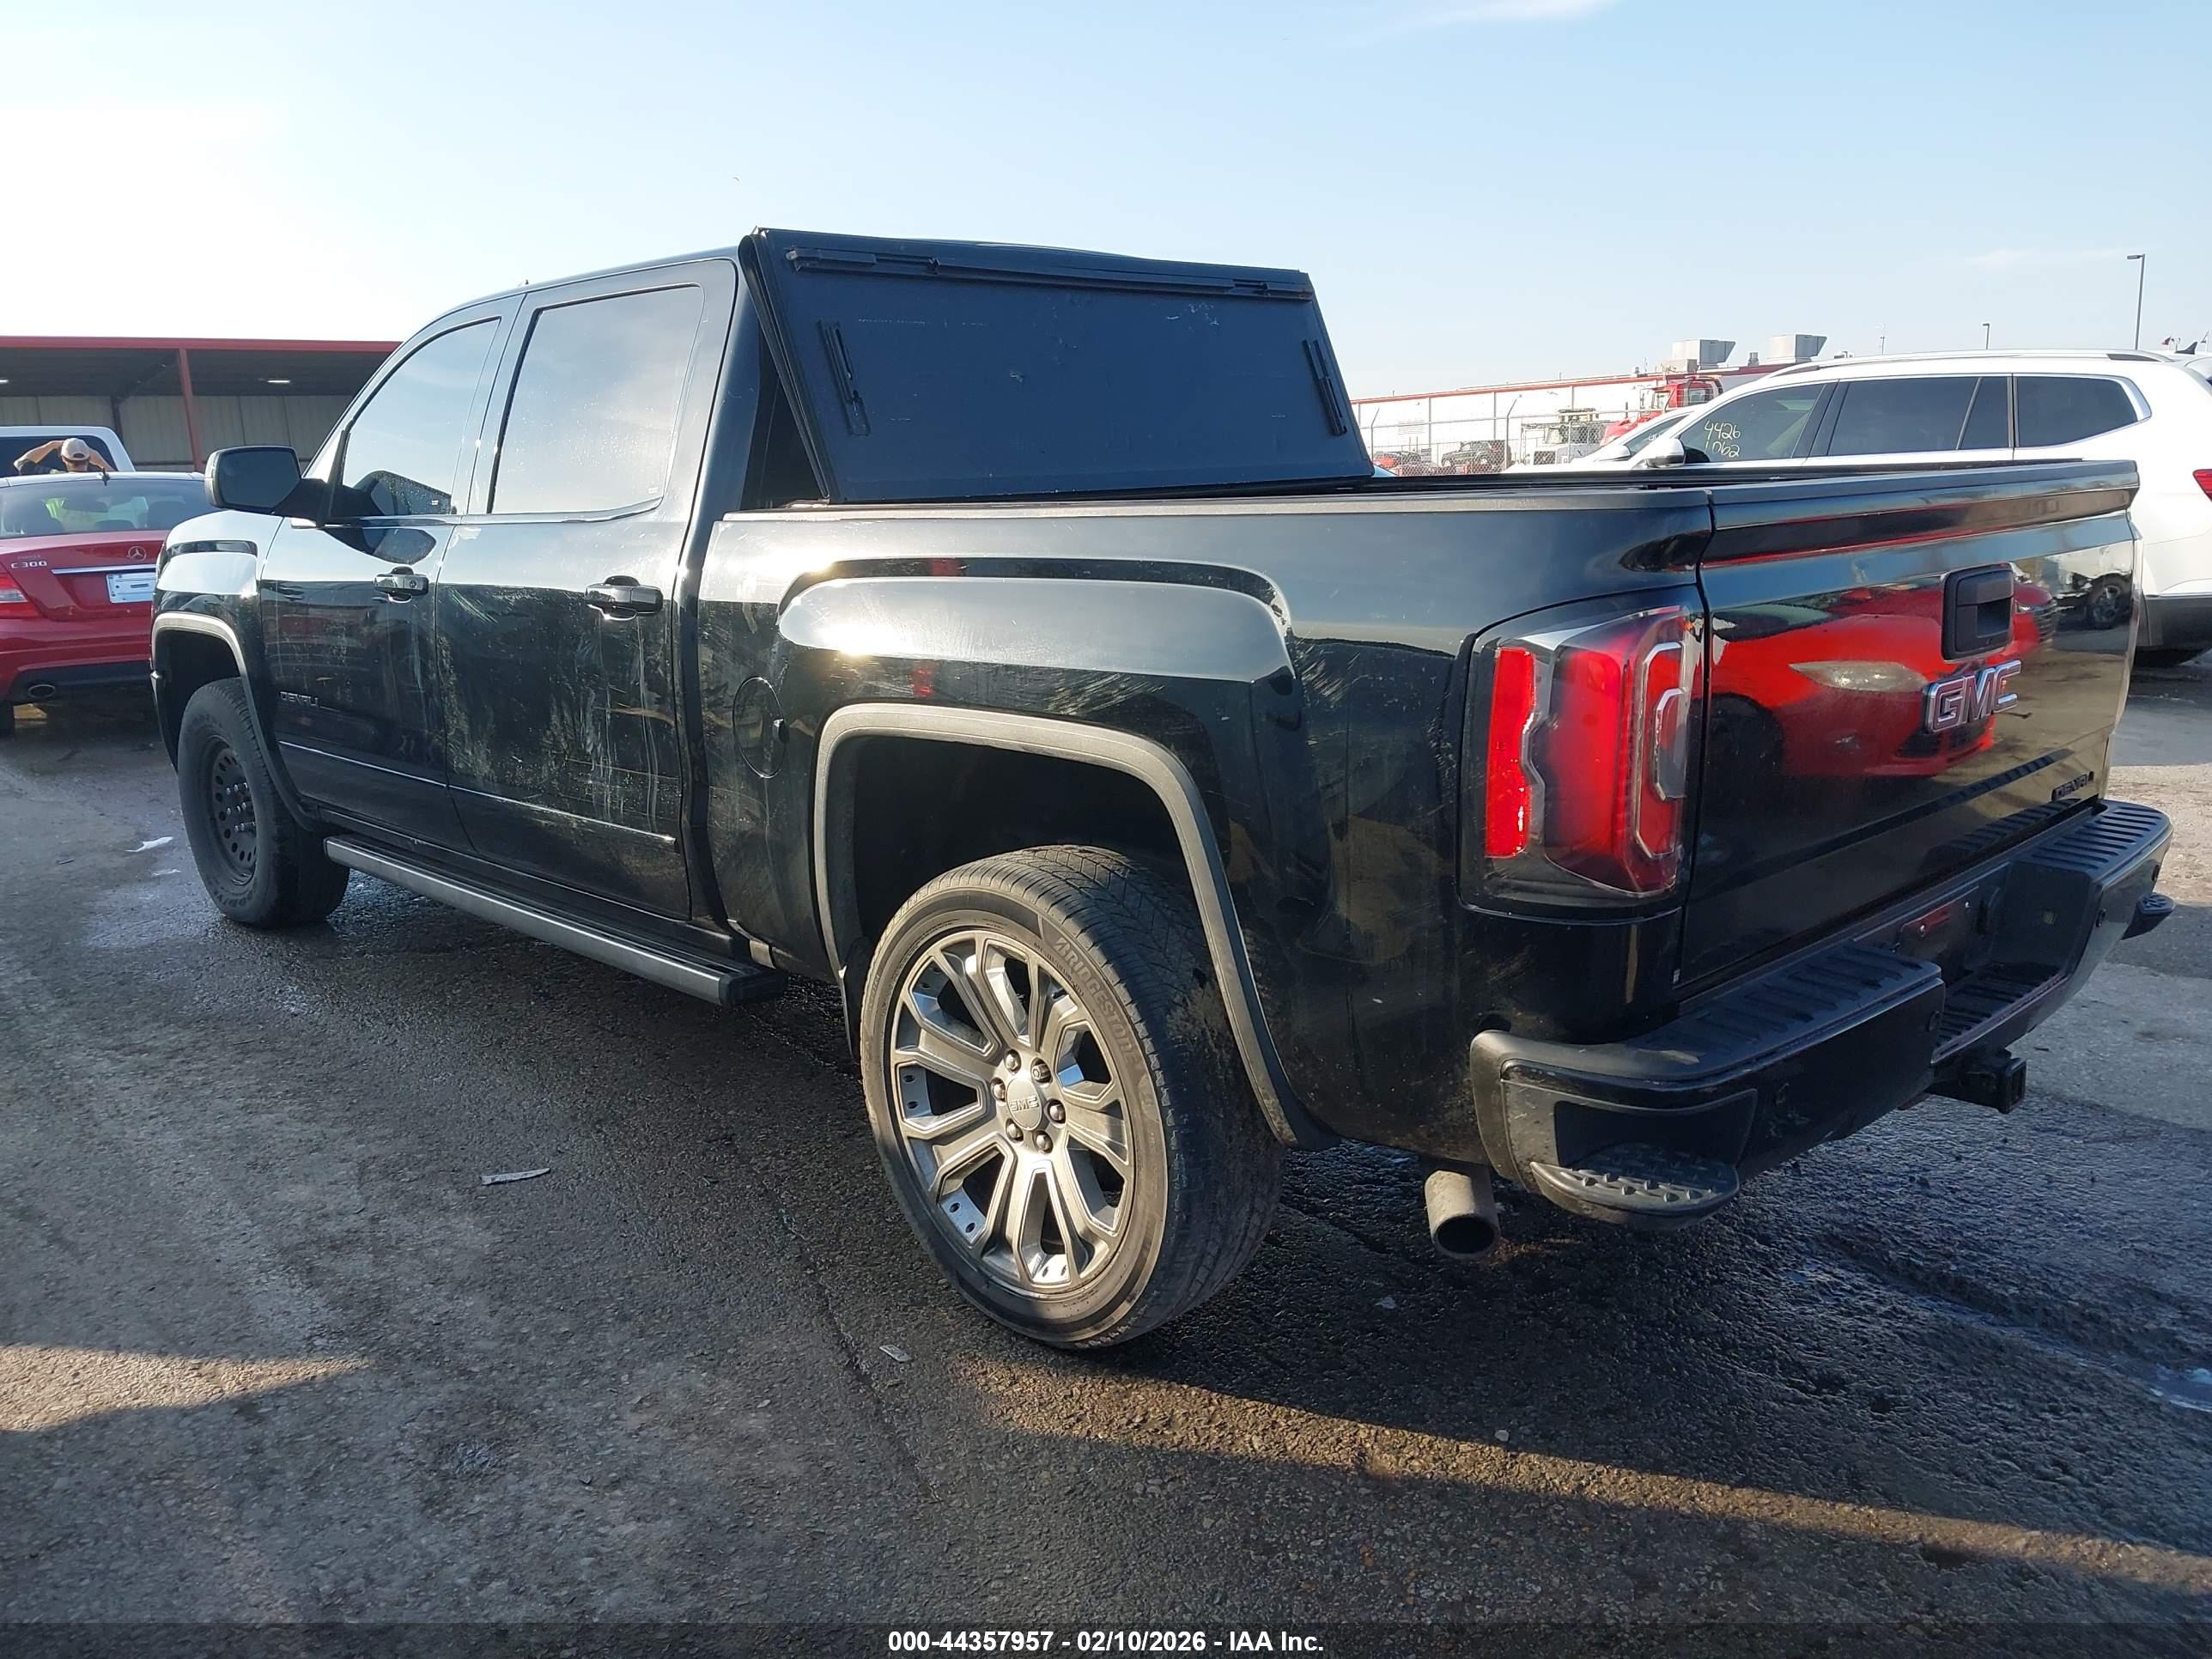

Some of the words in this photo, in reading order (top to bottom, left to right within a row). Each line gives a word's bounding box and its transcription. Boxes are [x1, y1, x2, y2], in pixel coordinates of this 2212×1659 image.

[1705, 420, 1741, 440] 4426
[1705, 440, 1741, 458] 1062
[279, 690, 319, 708] DENALI
[1925, 660, 2021, 733] GMC
[1053, 938, 1141, 1065] BRIDGESTONE
[1009, 1096, 1039, 1112] GMC
